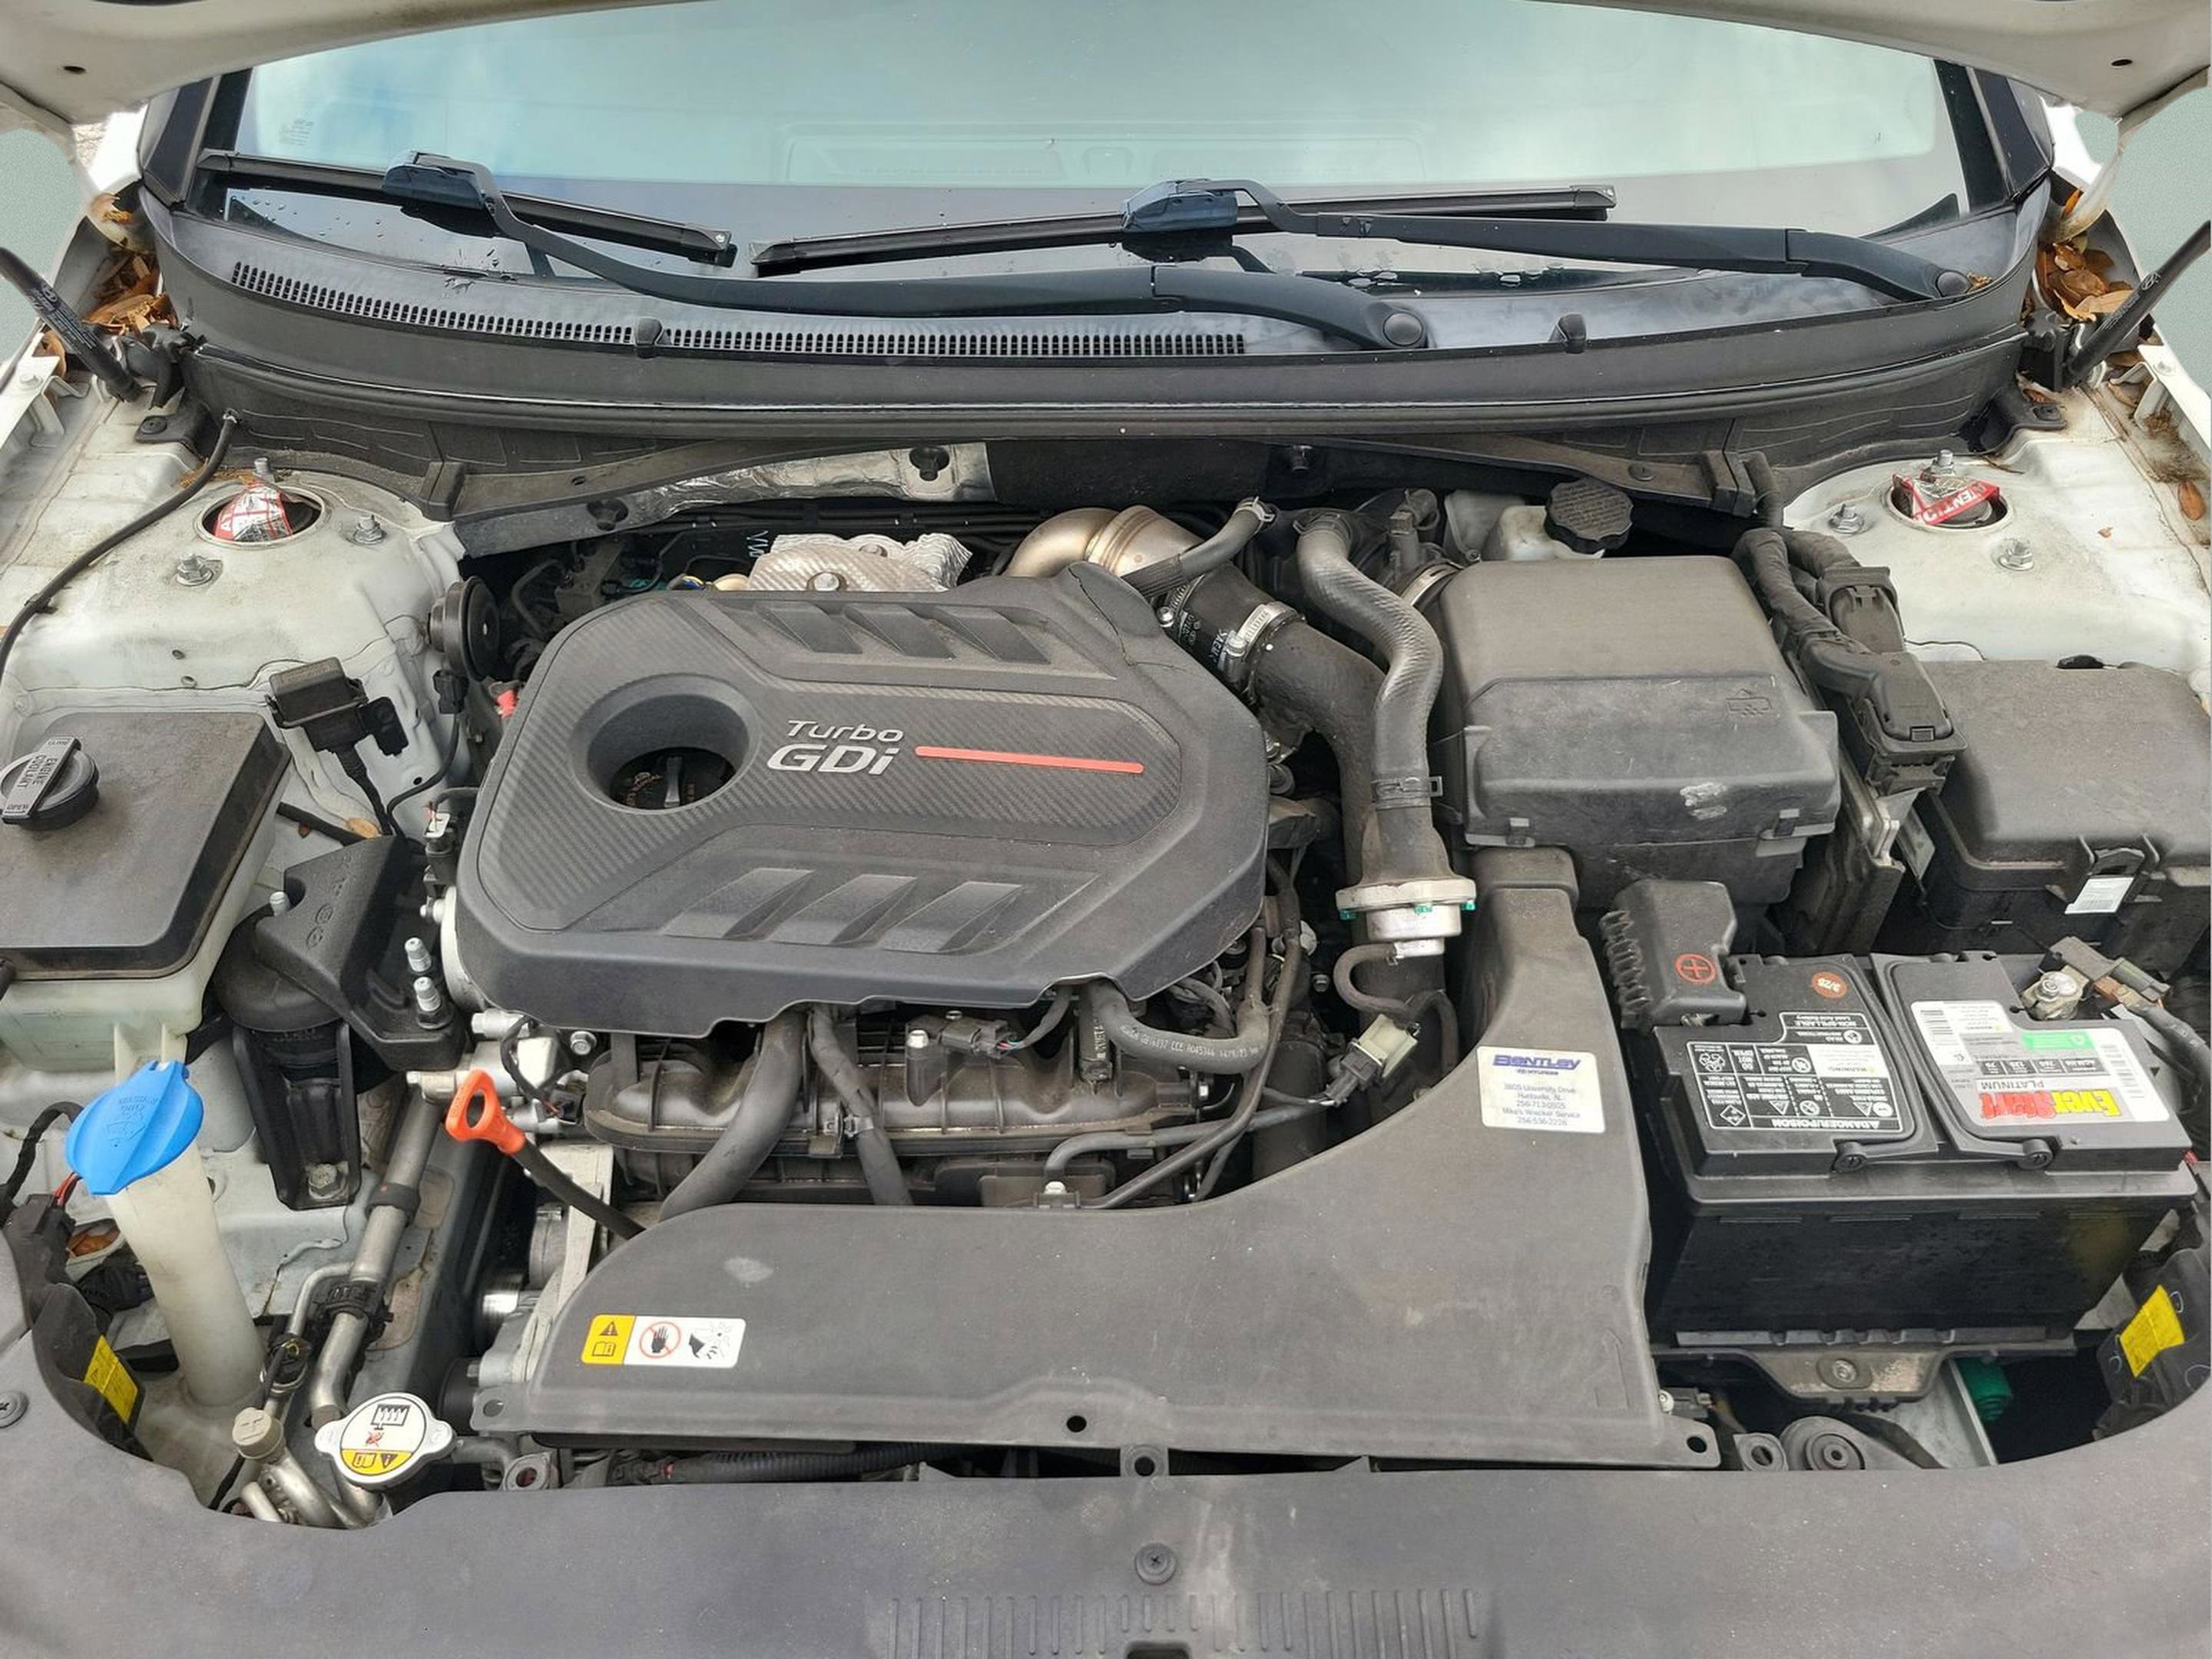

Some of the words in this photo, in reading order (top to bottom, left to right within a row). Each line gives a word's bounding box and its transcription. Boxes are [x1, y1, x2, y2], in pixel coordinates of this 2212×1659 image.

[788, 720, 904, 742] Turbo
[767, 743, 900, 776] GDi
[1980, 1080, 2045, 1089] PLATINUM
